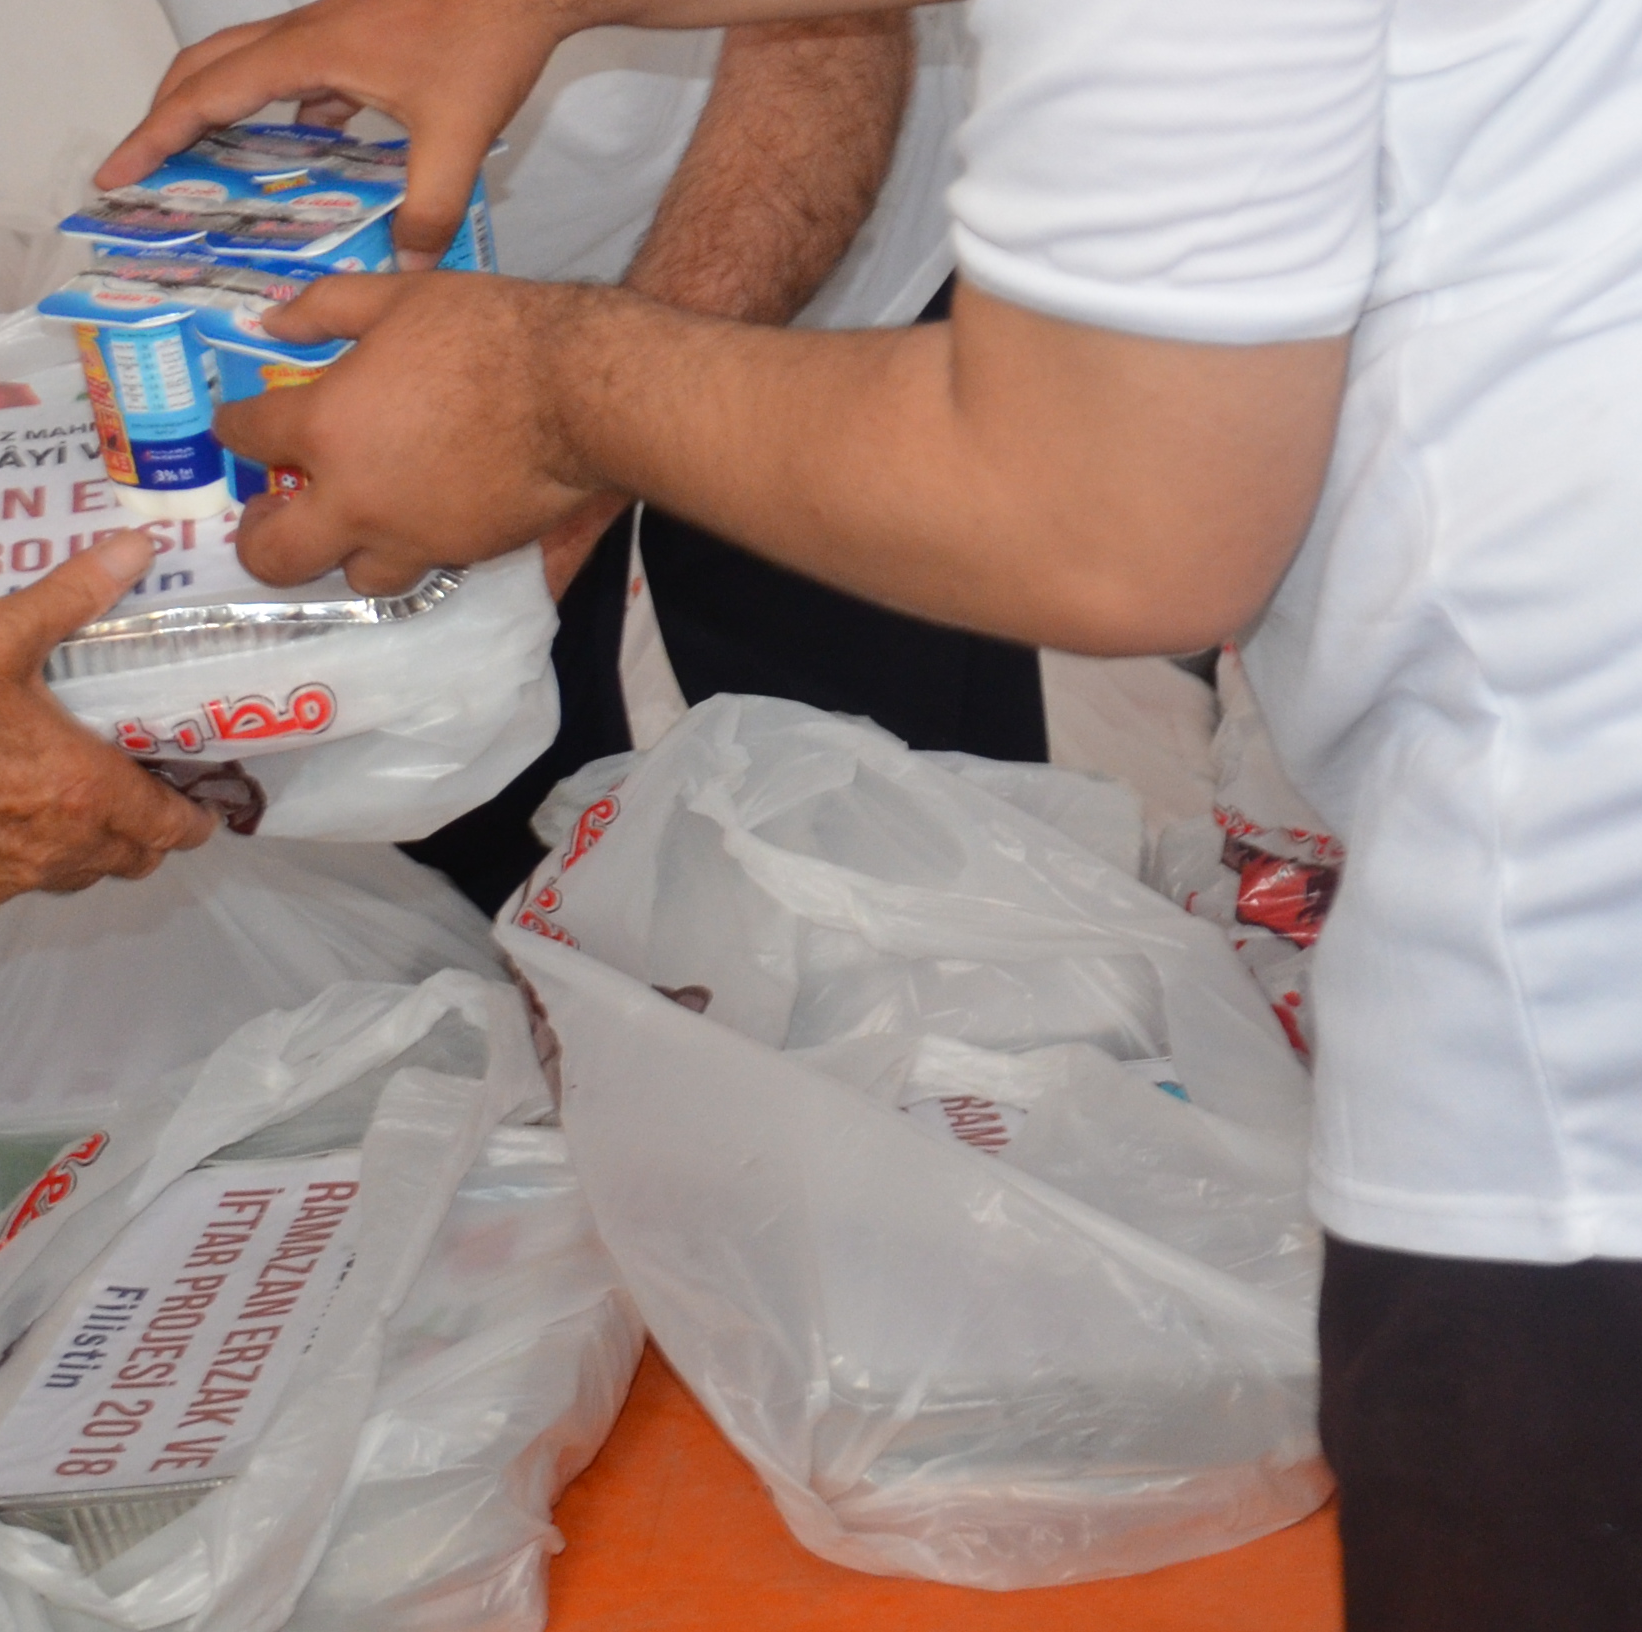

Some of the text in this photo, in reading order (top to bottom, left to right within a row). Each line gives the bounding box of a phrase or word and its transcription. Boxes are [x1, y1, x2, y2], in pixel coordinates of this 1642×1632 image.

[183, 1187, 286, 1268] İFTAR
[237, 1180, 360, 1320] RAMAZAN
[44, 1285, 150, 1388] Filistin
[177, 1324, 284, 1429] ERZAK
[55, 1398, 155, 1476] 2018
[148, 1434, 227, 1472] VE
